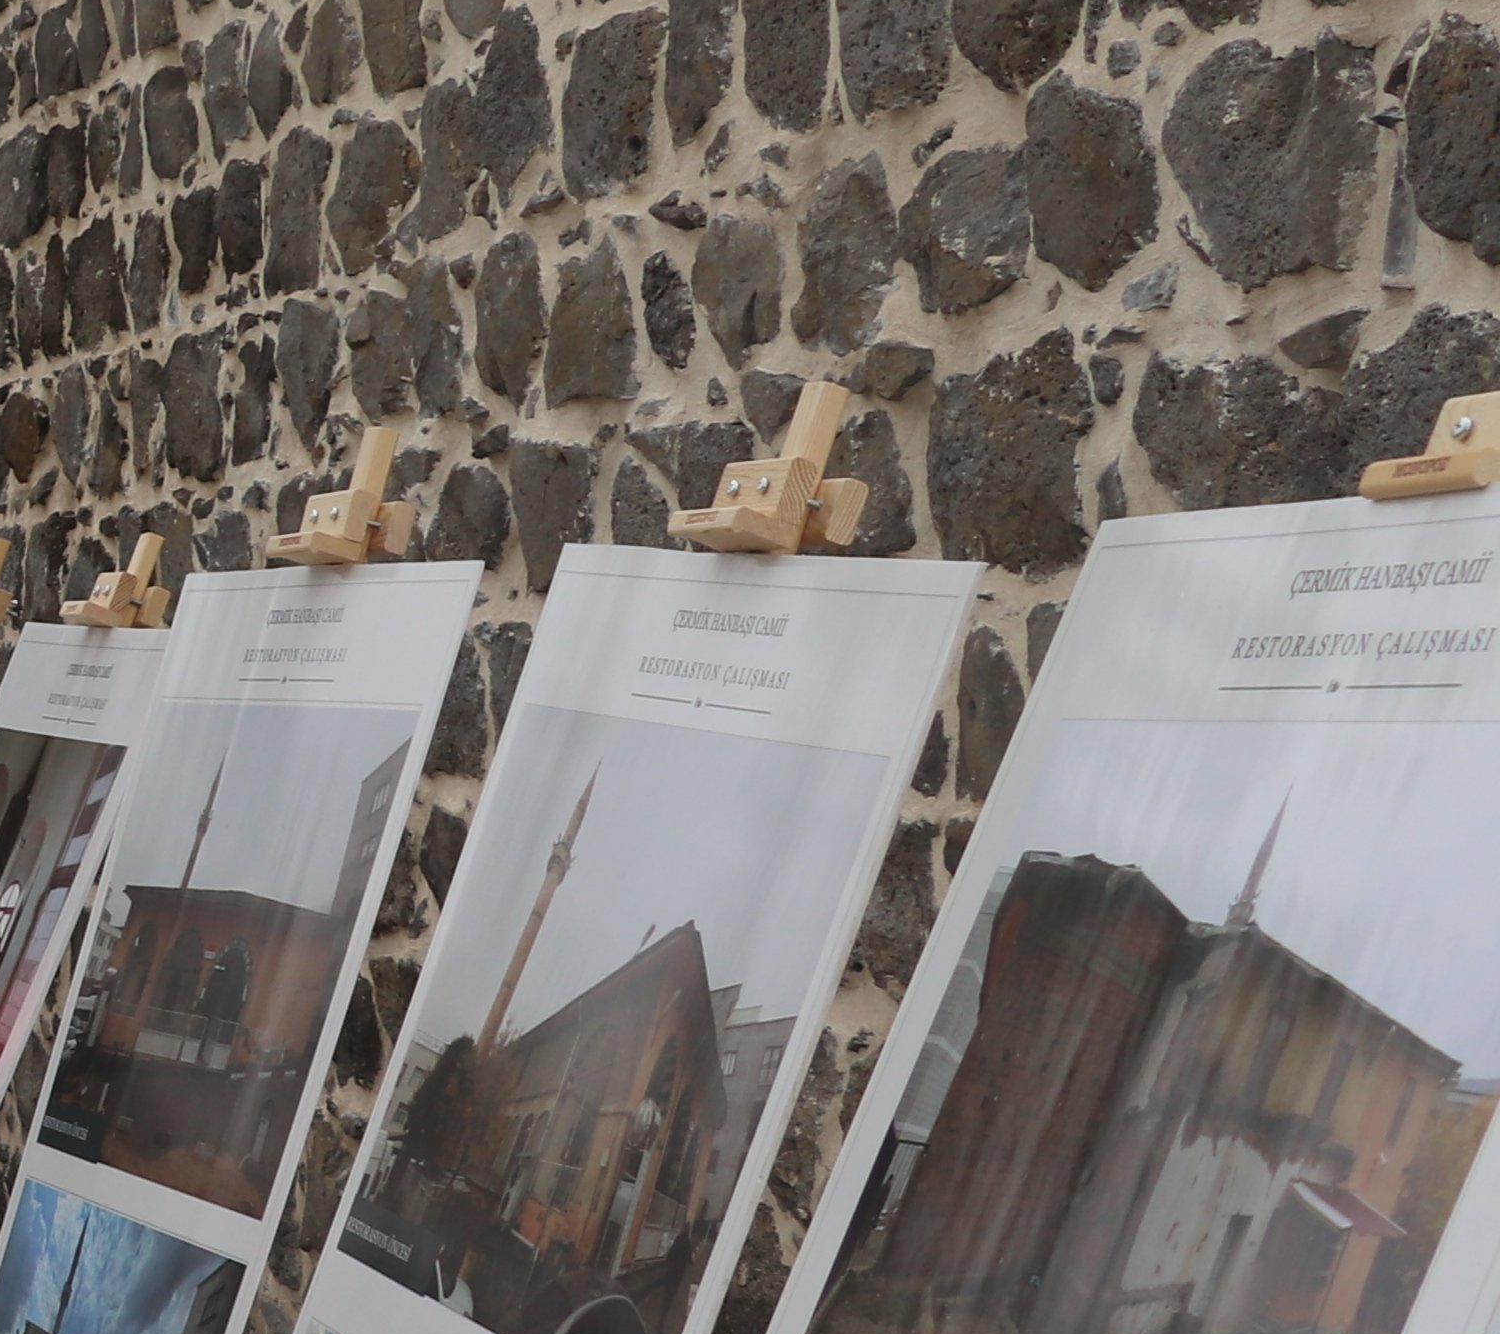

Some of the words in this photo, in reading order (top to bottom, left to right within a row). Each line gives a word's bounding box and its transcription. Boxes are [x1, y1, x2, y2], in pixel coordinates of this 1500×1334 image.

[1289, 562, 1358, 601] ÇERMİK
[1354, 562, 1436, 594] HANBAŞI
[1231, 631, 1373, 659] RESTORASYON
[1375, 627, 1497, 661] ÇALIŞMASI
[638, 656, 722, 681] RESTORASYON
[722, 666, 790, 690] ÇALIŞMASI
